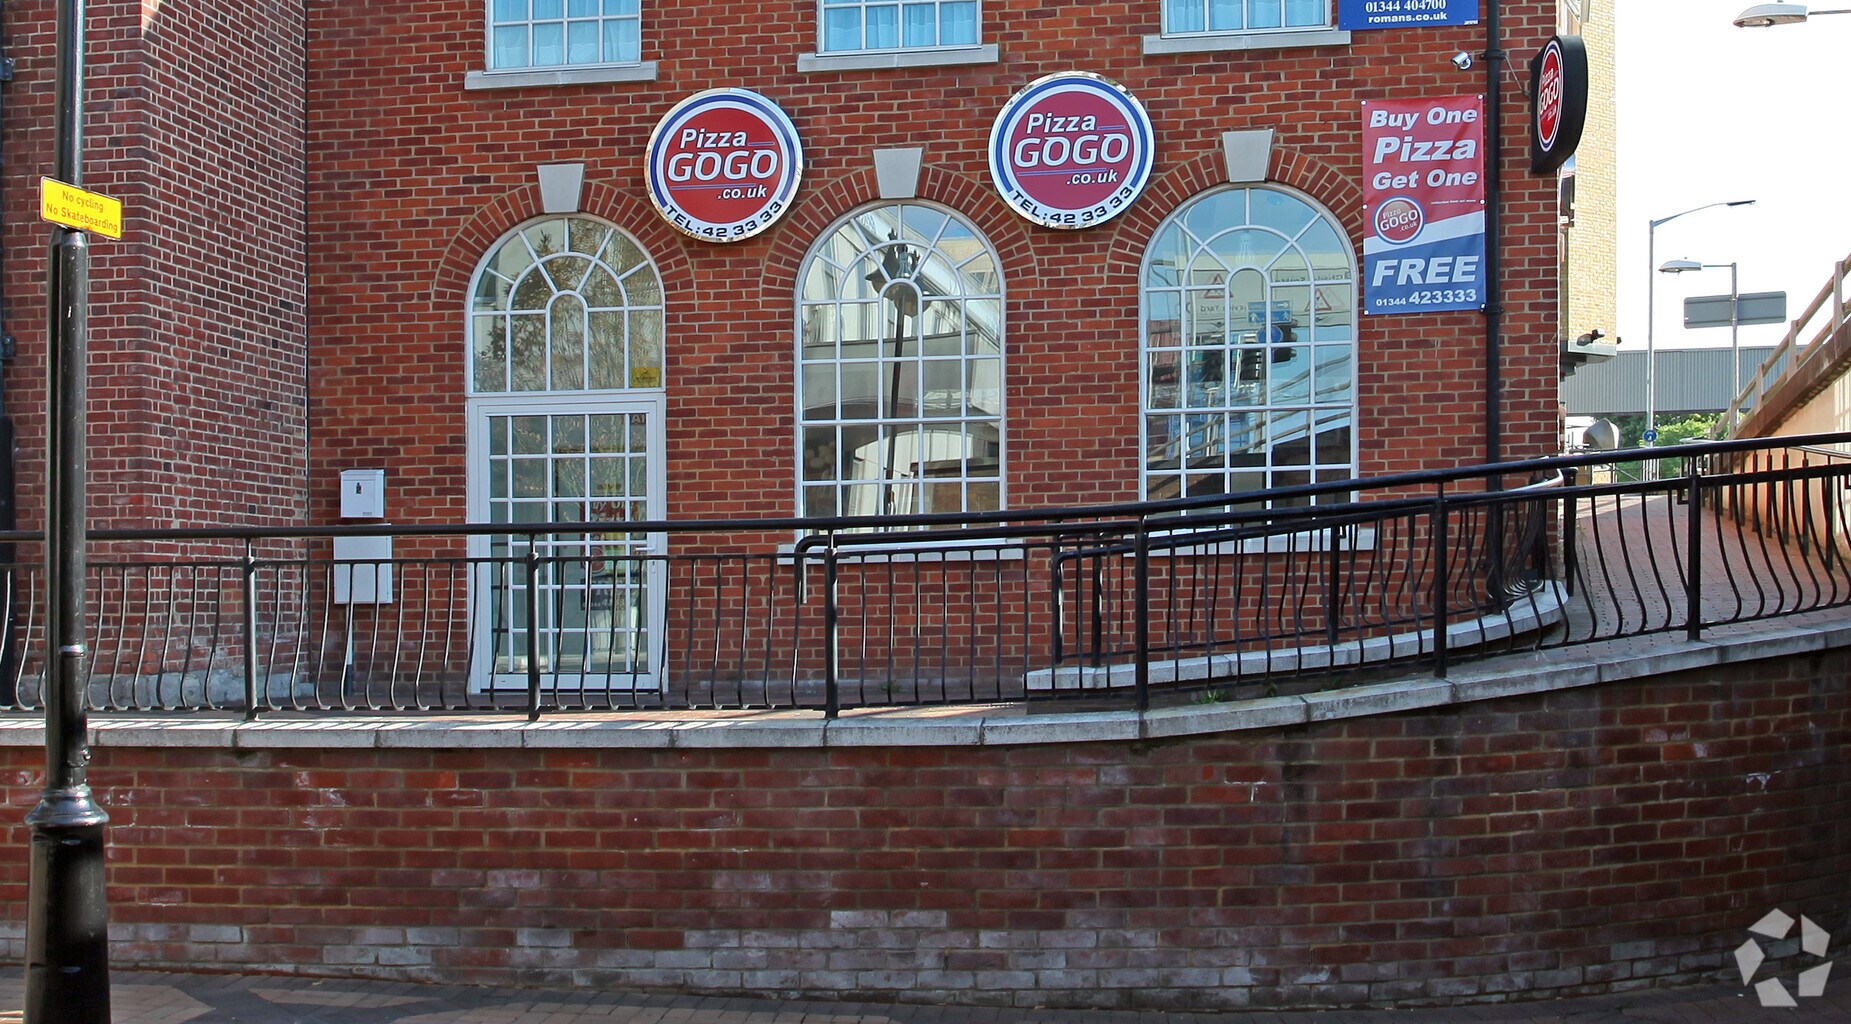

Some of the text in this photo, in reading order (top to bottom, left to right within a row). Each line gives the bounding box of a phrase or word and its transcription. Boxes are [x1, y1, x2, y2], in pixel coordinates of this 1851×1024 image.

[1365, 0, 1400, 13] 01344
[1368, 12, 1447, 23] romans.co.uk
[1026, 113, 1096, 134] Pizza
[1369, 107, 1478, 130] Buy One
[680, 128, 747, 149] Pizza
[1014, 133, 1130, 167] GOGO
[1372, 136, 1476, 164] Pizza
[668, 150, 778, 182] GOGO
[1066, 169, 1118, 184] .co.uk
[1372, 169, 1477, 190] Get One
[62, 190, 104, 213] No cycling
[717, 185, 767, 199] .co.uk
[46, 203, 118, 233] No Skateboarding
[1380, 210, 1418, 231] GOGO
[1372, 256, 1479, 287] FREE
[1376, 289, 1476, 307] 01344 423333
